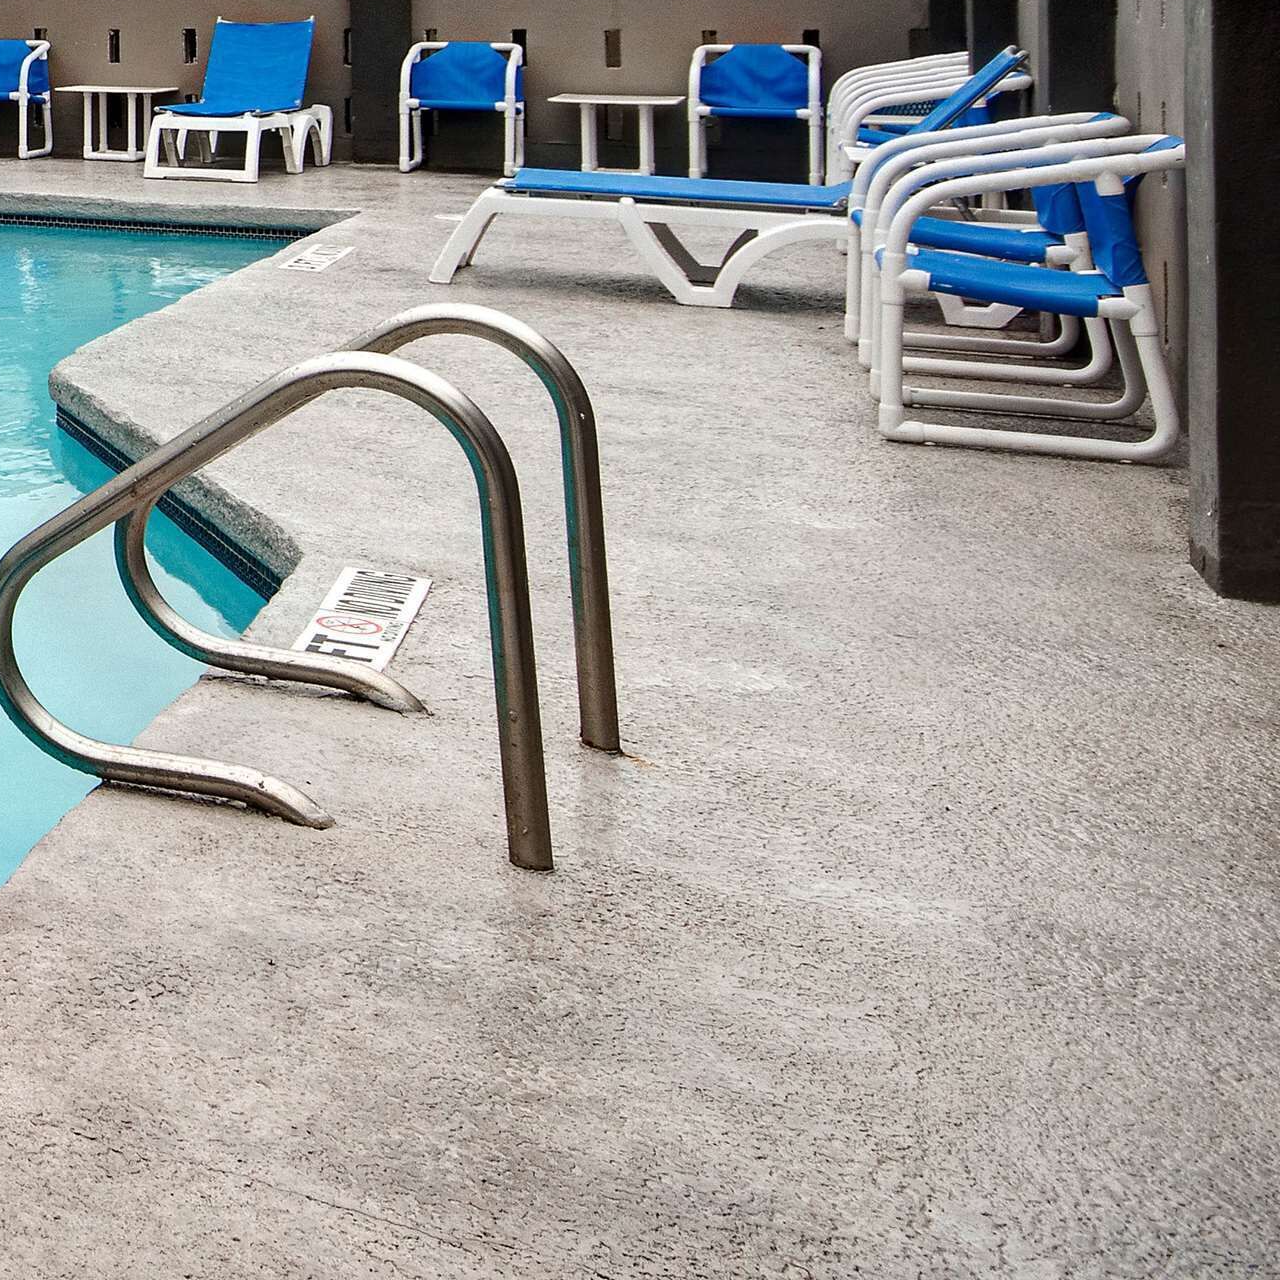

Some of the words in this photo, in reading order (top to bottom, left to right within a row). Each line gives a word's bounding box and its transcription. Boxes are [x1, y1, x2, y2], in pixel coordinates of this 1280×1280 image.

[343, 571, 417, 605] DIVING
[334, 600, 401, 619] NO
[305, 633, 380, 663] FT
